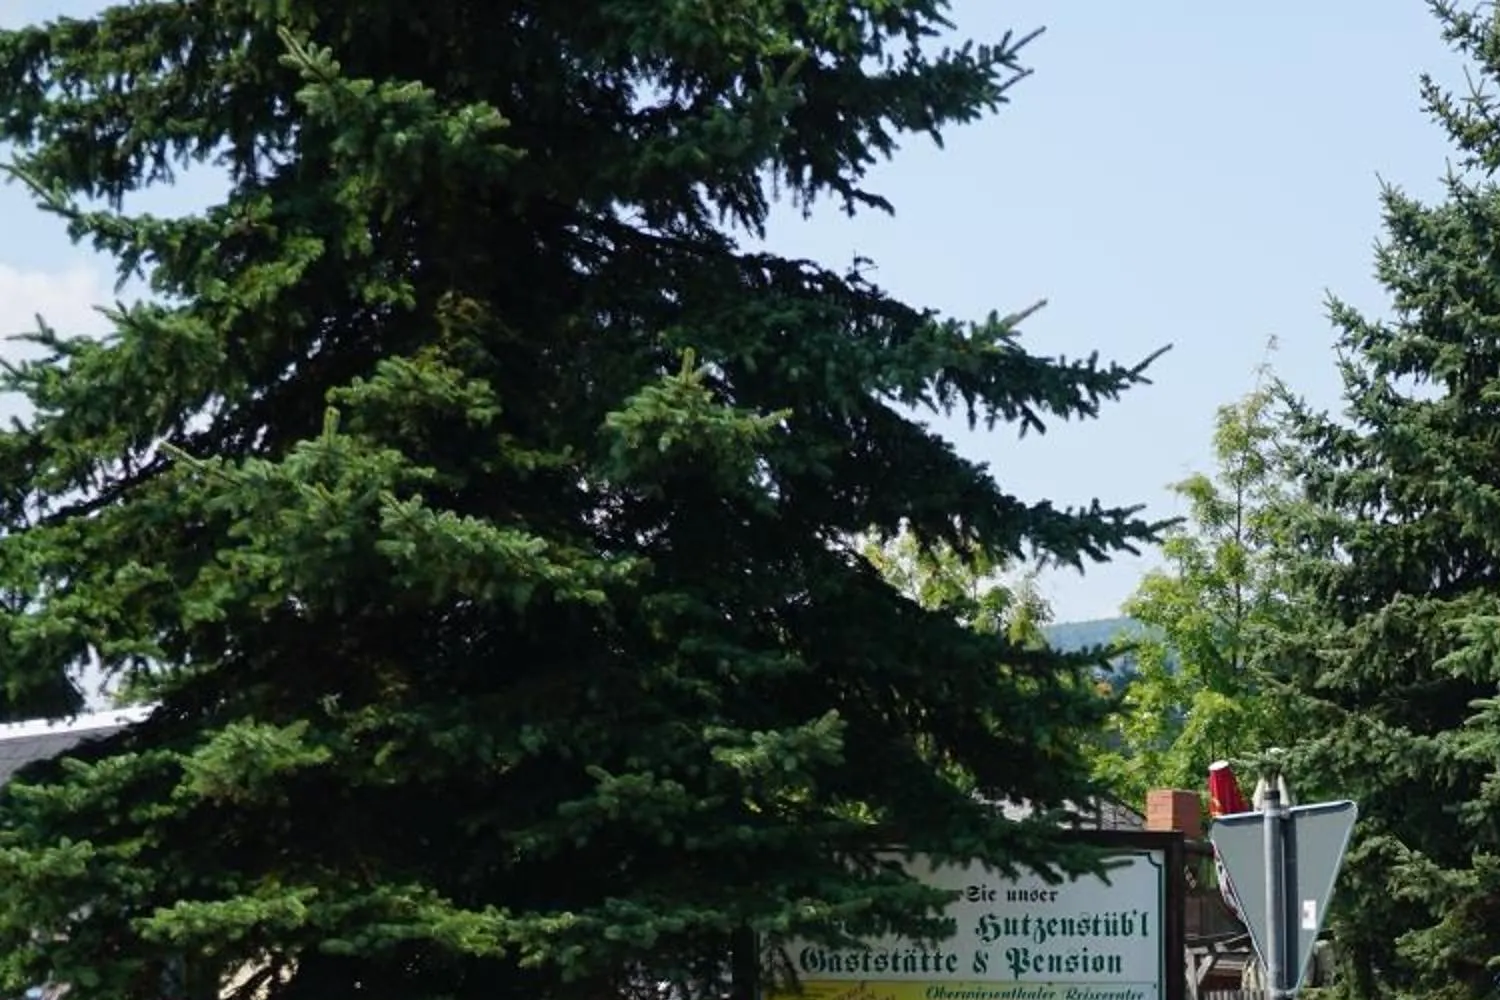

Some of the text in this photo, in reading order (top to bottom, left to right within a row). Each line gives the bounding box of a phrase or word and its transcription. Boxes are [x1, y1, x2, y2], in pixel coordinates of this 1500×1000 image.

[966, 884, 1059, 903] Sie unser
[800, 947, 959, 974] Gaststätte
[1005, 946, 1122, 980] Pension
